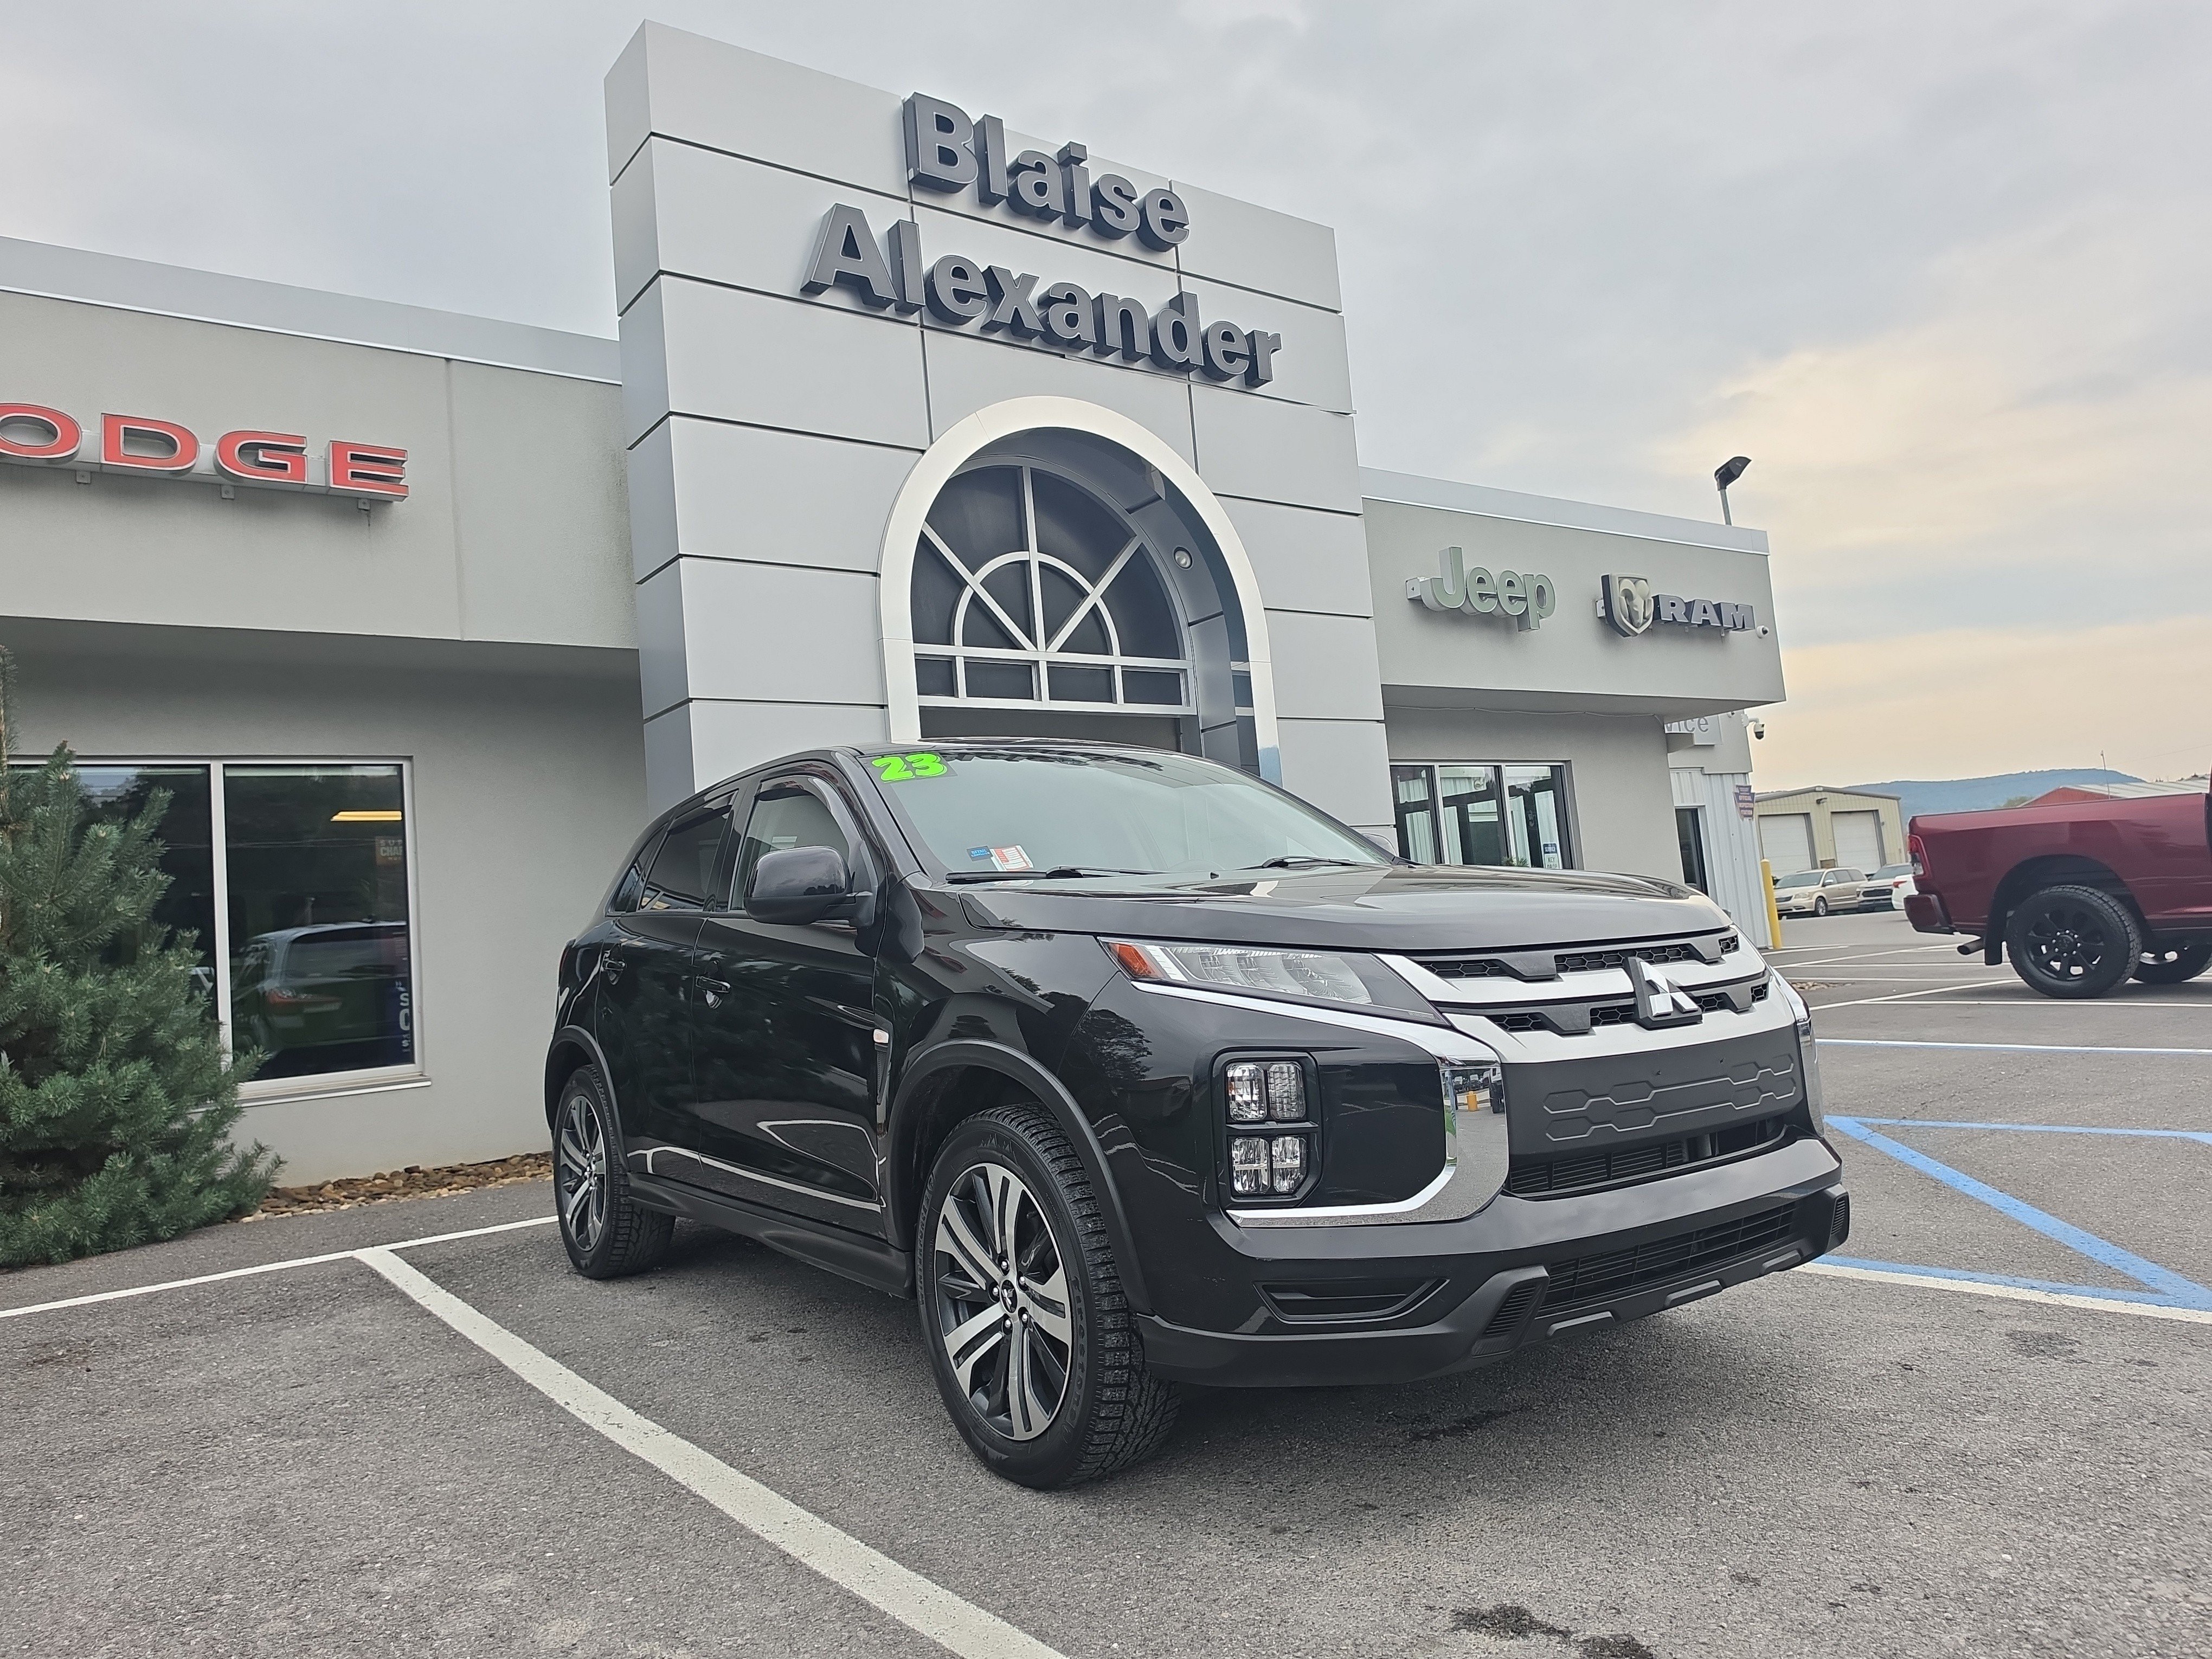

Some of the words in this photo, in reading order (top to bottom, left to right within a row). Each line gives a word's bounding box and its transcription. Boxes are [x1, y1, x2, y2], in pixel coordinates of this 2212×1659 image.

[903, 91, 1190, 252] Blaise
[800, 203, 1282, 388] Alexander
[1420, 546, 1557, 632] Jeep
[1656, 594, 1755, 632] RAM
[871, 753, 948, 784] 23
